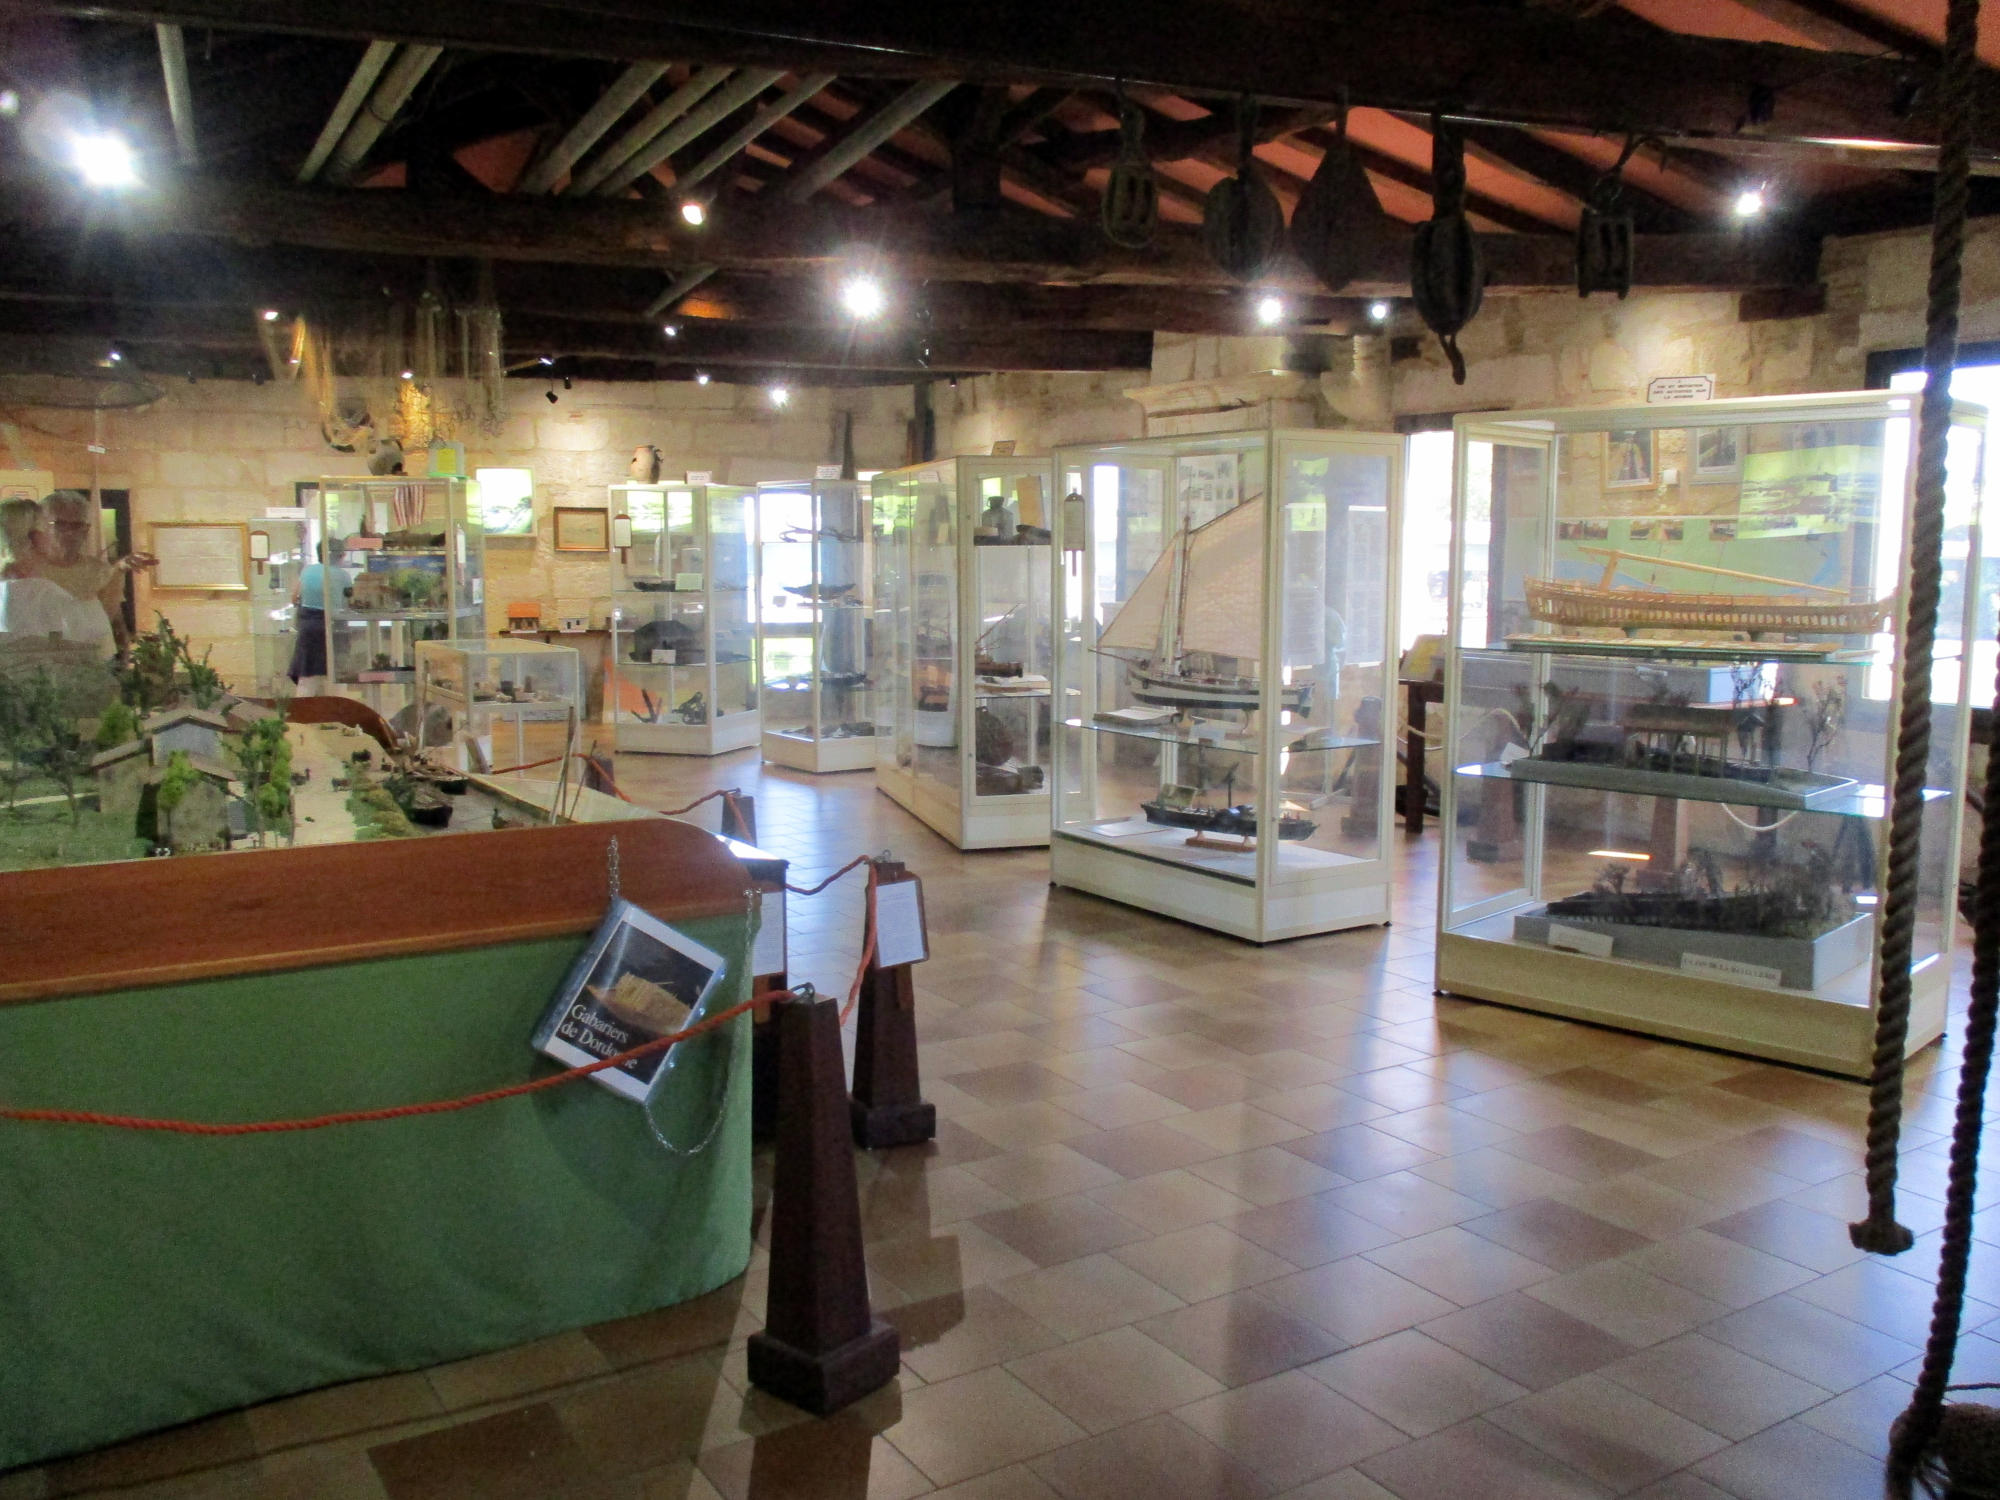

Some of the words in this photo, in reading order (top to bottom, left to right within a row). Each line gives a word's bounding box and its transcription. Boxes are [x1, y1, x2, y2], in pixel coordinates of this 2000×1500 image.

[560, 1021, 578, 1038] de
[578, 1028, 637, 1069] Dordoe
[571, 1004, 628, 1043] Gabariers
